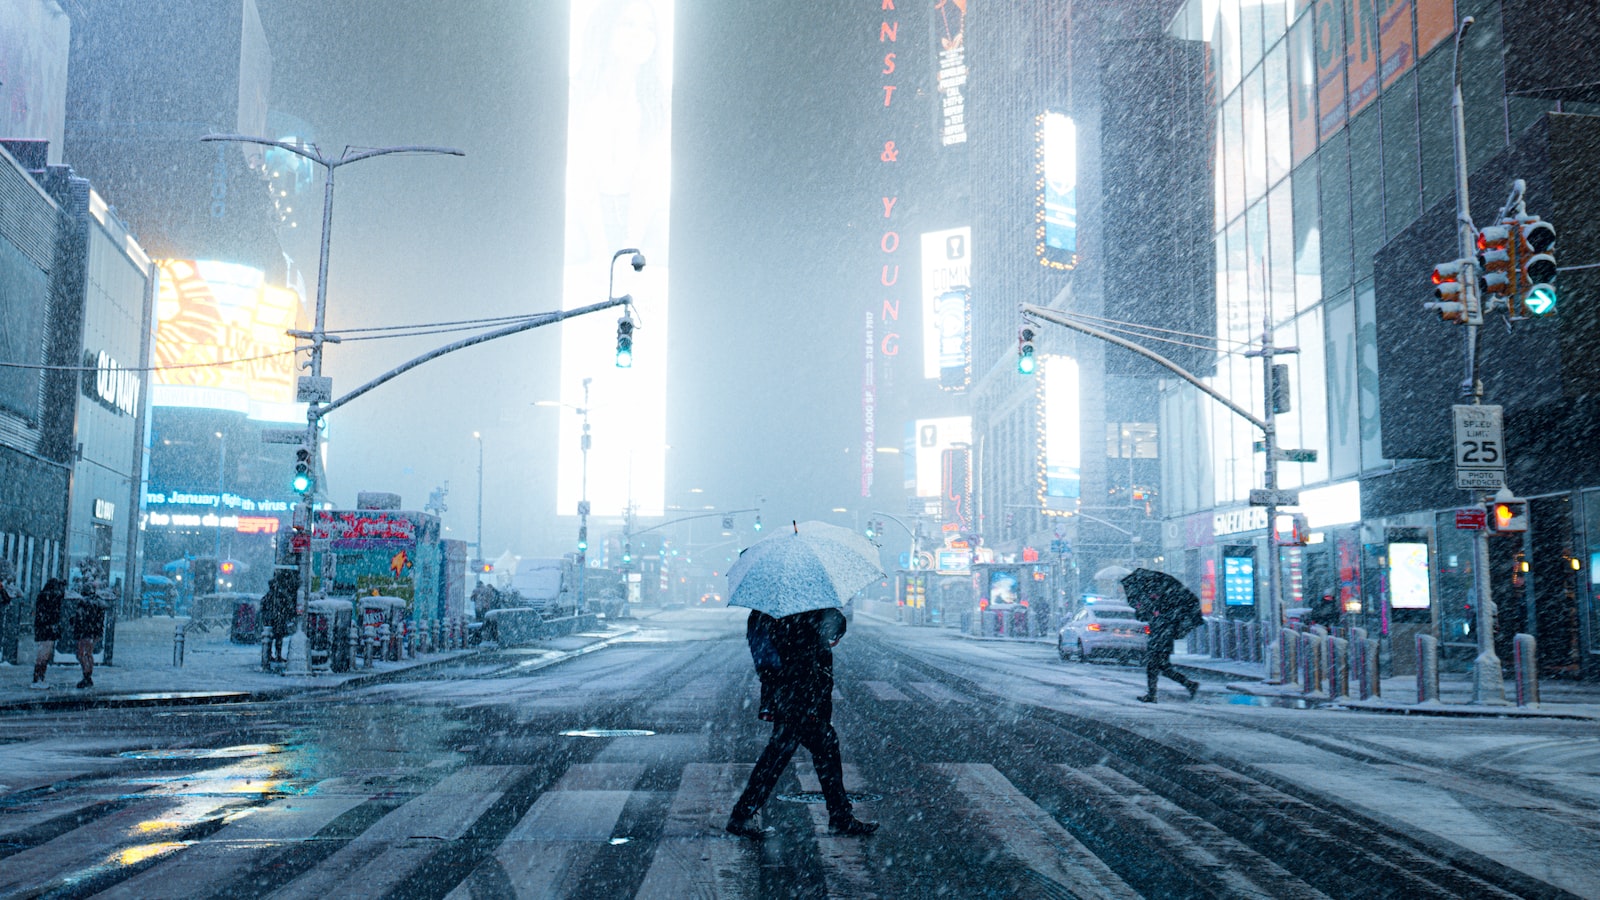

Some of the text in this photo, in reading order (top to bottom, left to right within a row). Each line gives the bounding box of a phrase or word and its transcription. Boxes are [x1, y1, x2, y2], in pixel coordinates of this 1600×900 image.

[880, 140, 898, 163] &
[880, 197, 900, 356] YOUNG
[97, 349, 117, 404] OLD
[115, 363, 141, 419] NAVY
[1462, 440, 1499, 463] 25
[167, 491, 220, 507] January
[258, 500, 288, 511] virus
[237, 515, 279, 534] ESPN
[1213, 506, 1268, 536] SKECHERS
